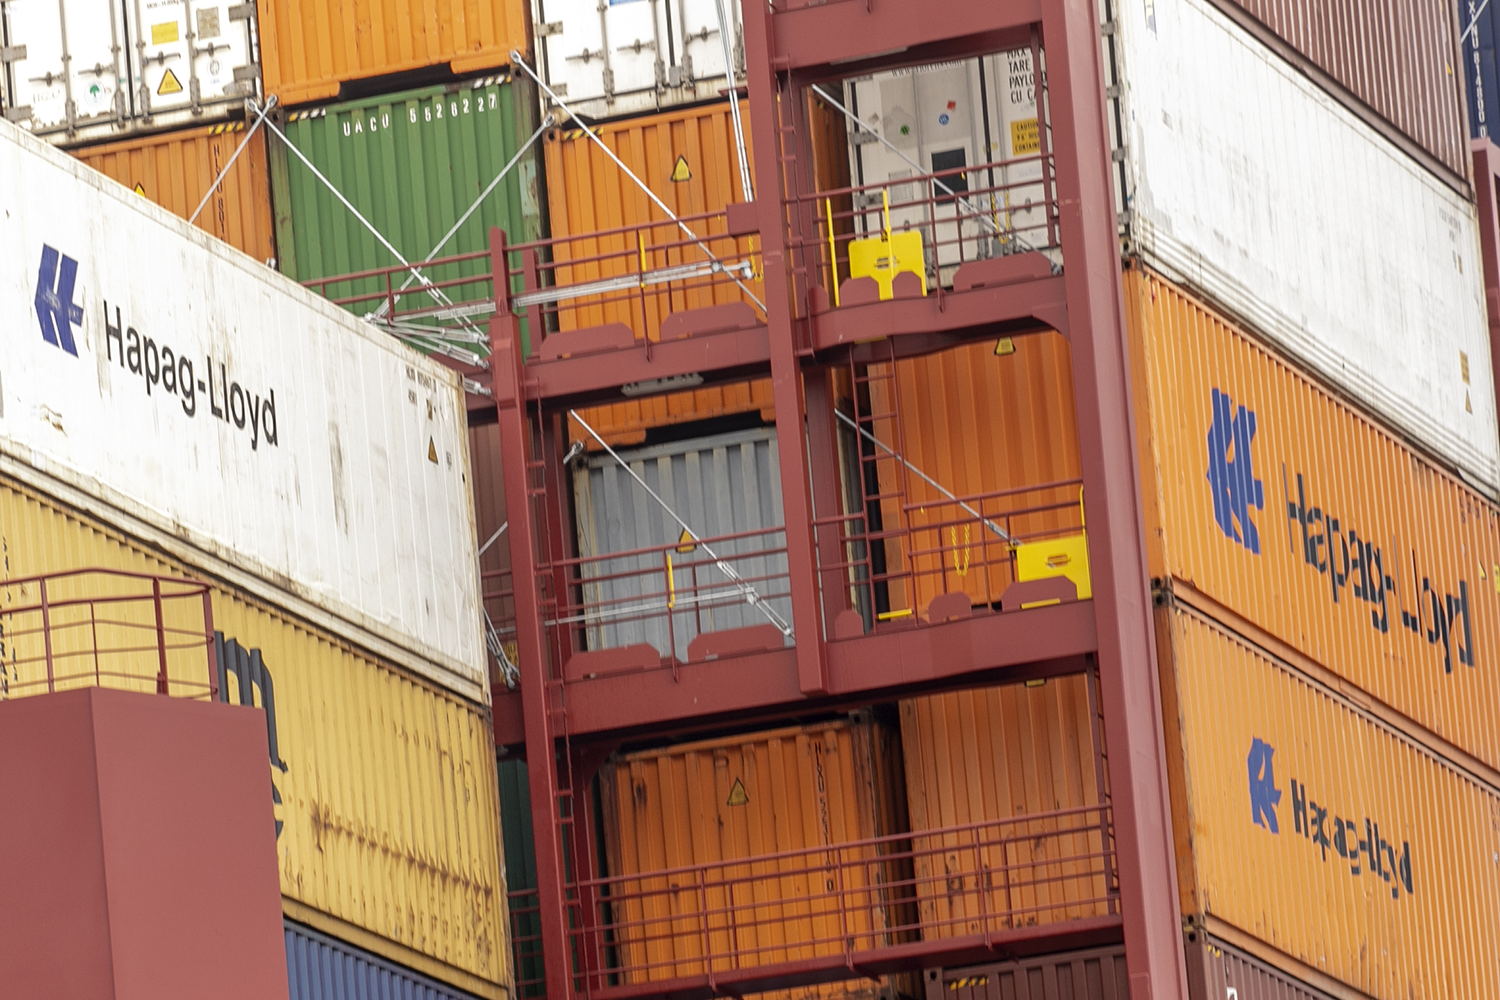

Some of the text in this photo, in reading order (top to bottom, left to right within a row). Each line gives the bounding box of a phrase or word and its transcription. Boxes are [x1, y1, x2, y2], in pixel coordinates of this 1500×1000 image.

[343, 112, 389, 137] UACU
[1008, 59, 1031, 74] TARE
[103, 299, 278, 451] Hapag-Lloyd
[1282, 462, 1474, 674] Hapag-Lloyd
[1290, 778, 1413, 900] Hapag-Lloyd
